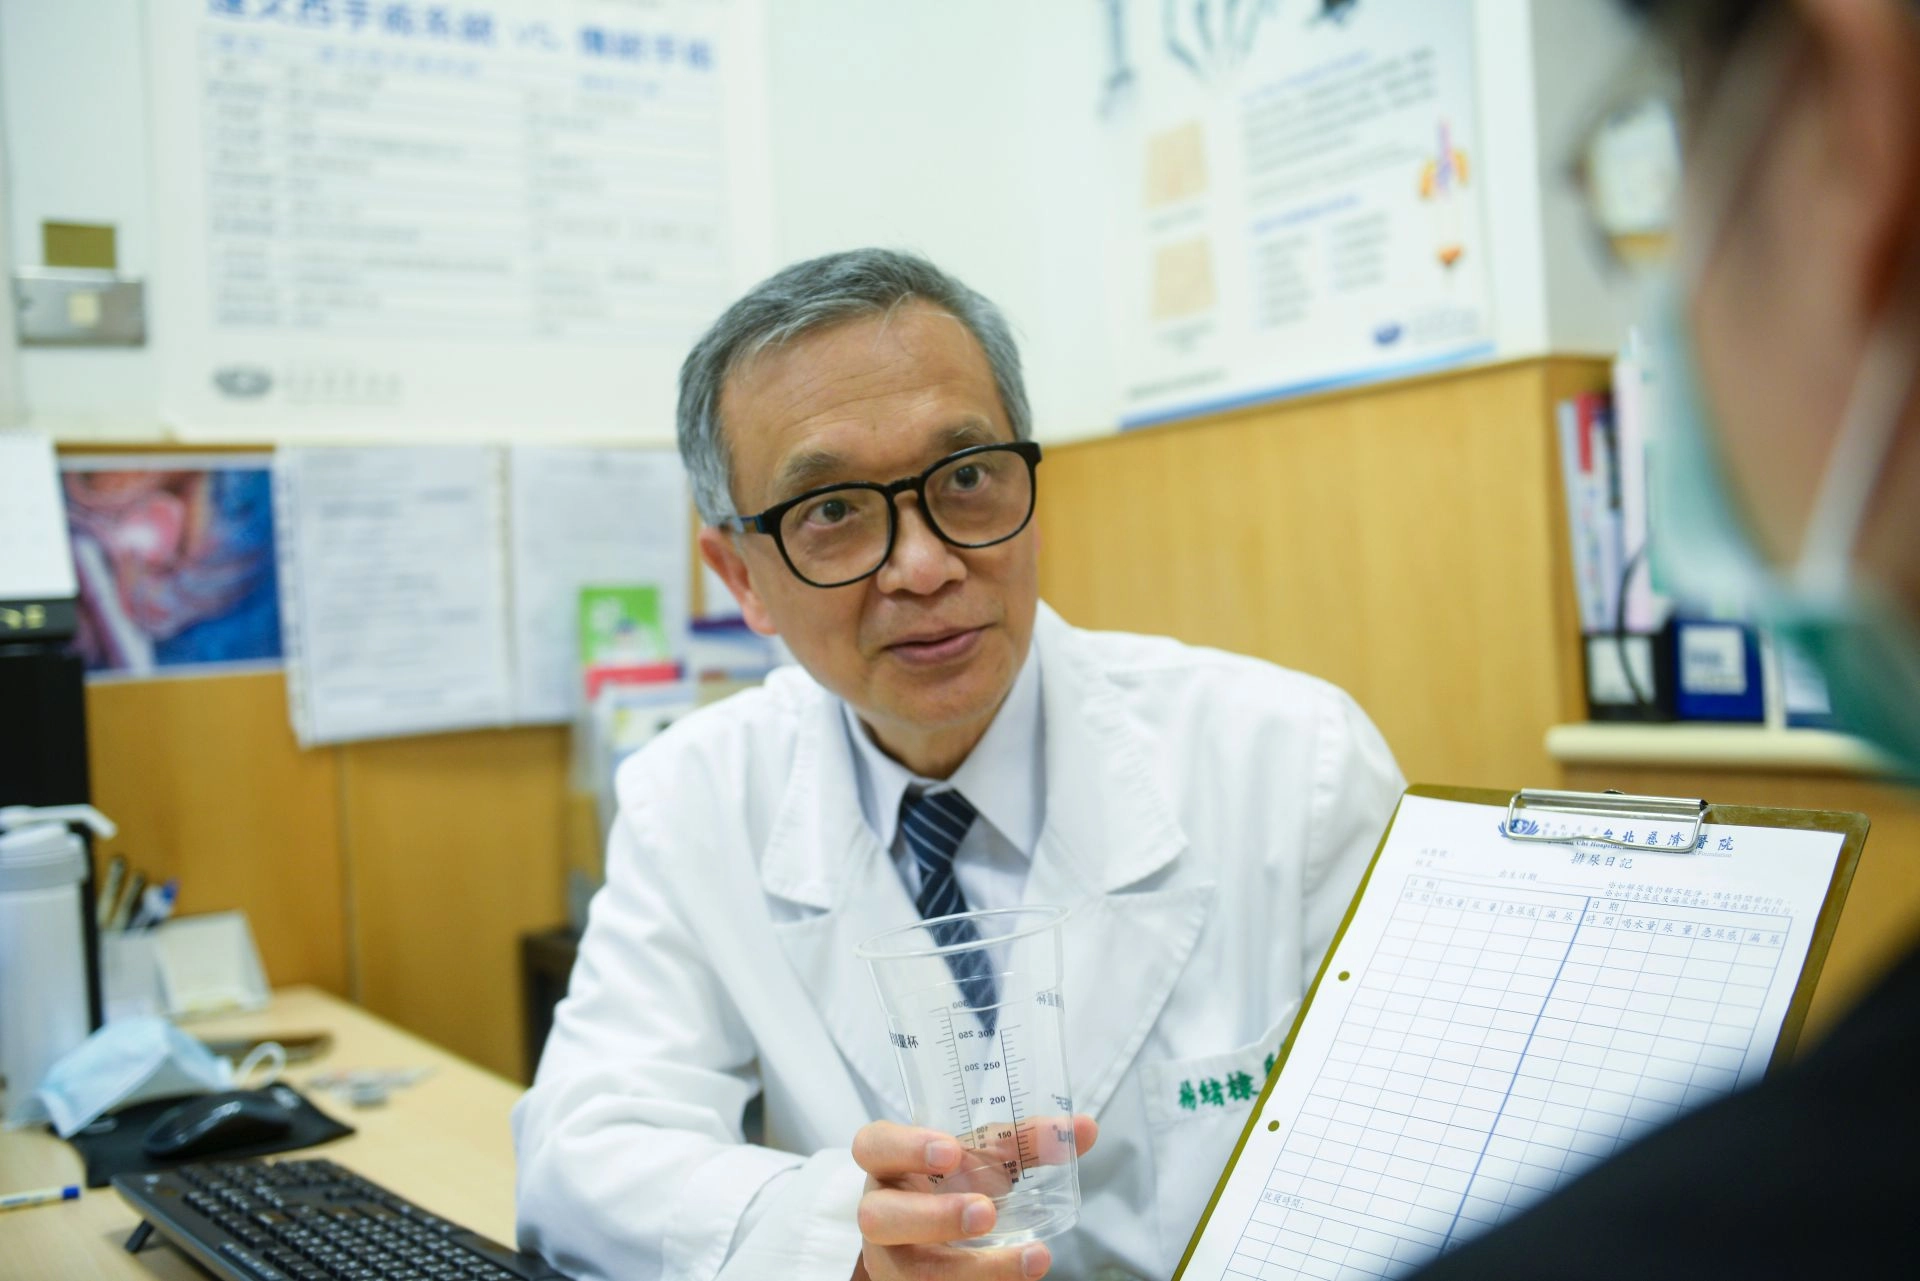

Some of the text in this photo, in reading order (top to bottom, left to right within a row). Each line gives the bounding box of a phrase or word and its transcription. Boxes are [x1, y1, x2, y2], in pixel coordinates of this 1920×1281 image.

[1603, 828, 1734, 851] 台北慈濟醫院
[1571, 852, 1633, 869] 排尿日記
[1621, 919, 1656, 931] 喝水量
[978, 1028, 996, 1039] 300
[983, 1060, 1001, 1071] 250
[989, 1095, 1007, 1105] 200
[998, 1131, 1012, 1139] 150
[1003, 1161, 1017, 1169] 100
